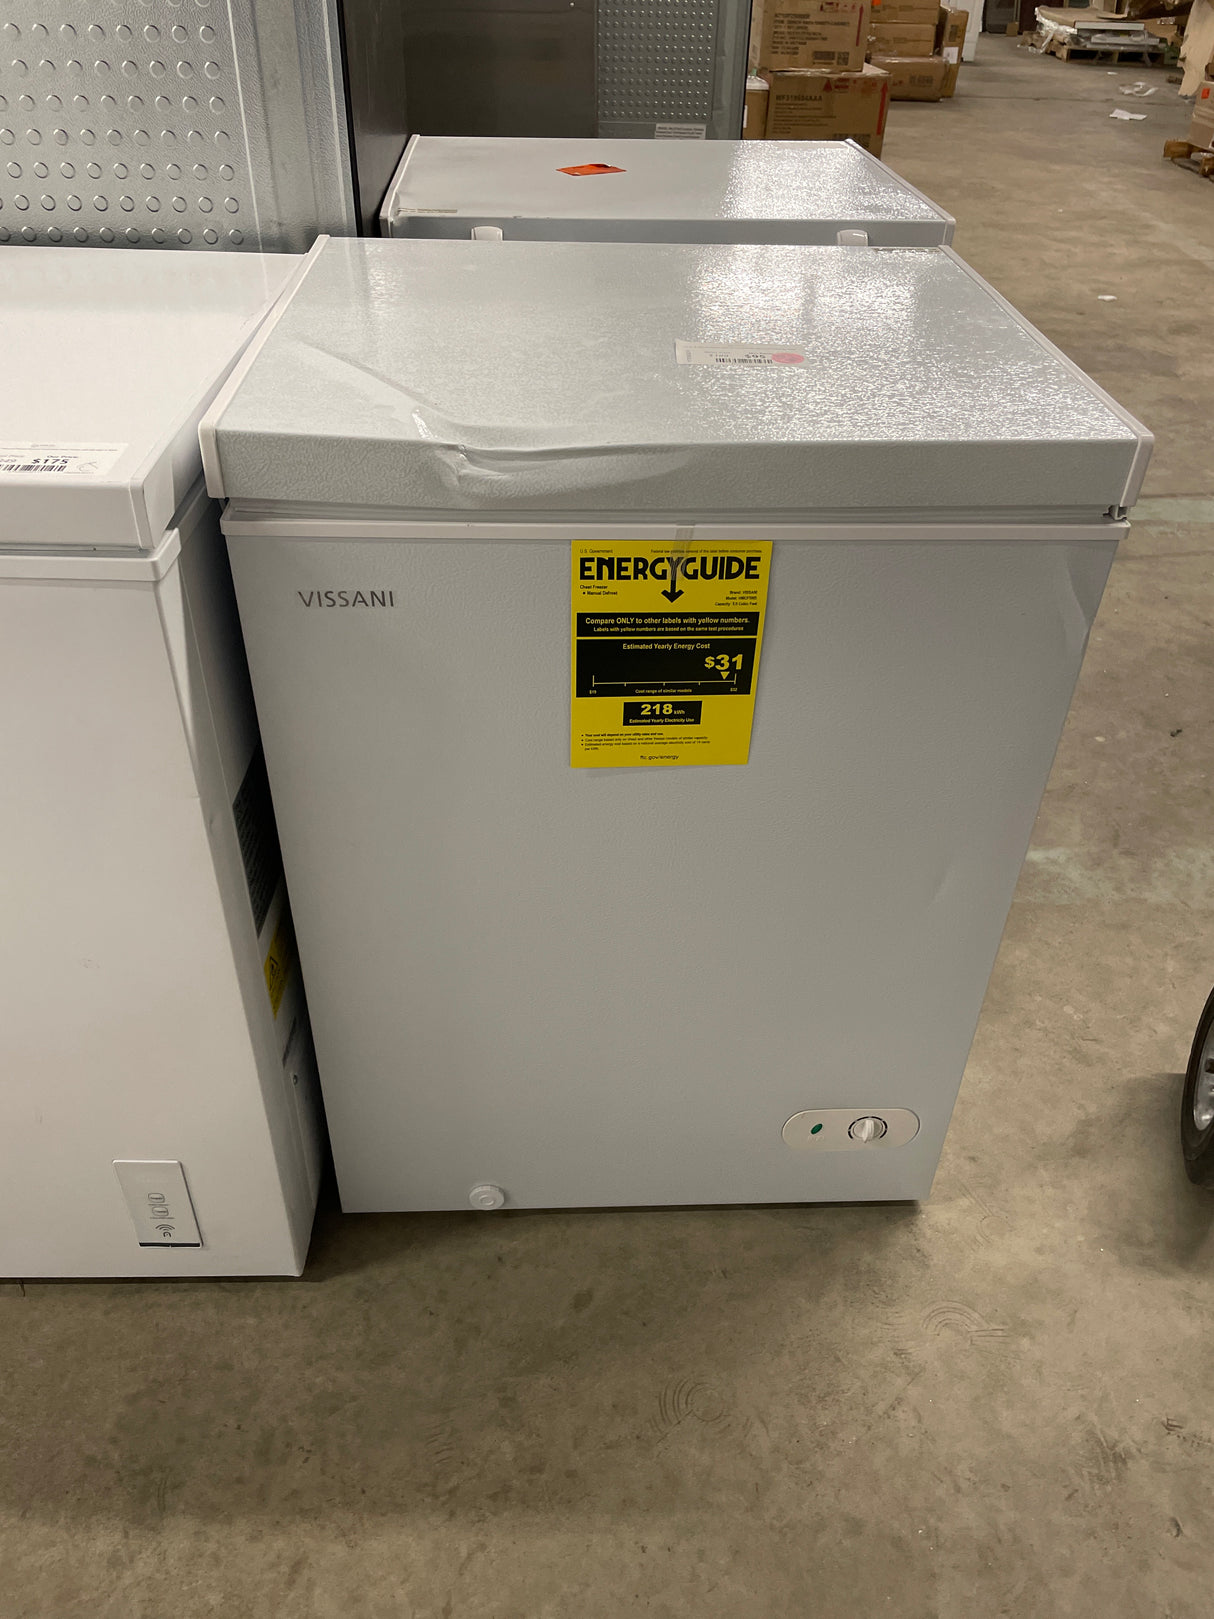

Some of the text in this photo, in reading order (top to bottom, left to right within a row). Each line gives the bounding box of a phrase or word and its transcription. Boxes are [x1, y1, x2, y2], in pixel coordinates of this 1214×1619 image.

[580, 556, 761, 580] ENERGYGUIDE
[298, 591, 394, 607] VISSANI
[585, 617, 615, 625] Compare
[698, 617, 719, 625] yellow
[704, 654, 743, 670] $31
[641, 703, 673, 715] 218
